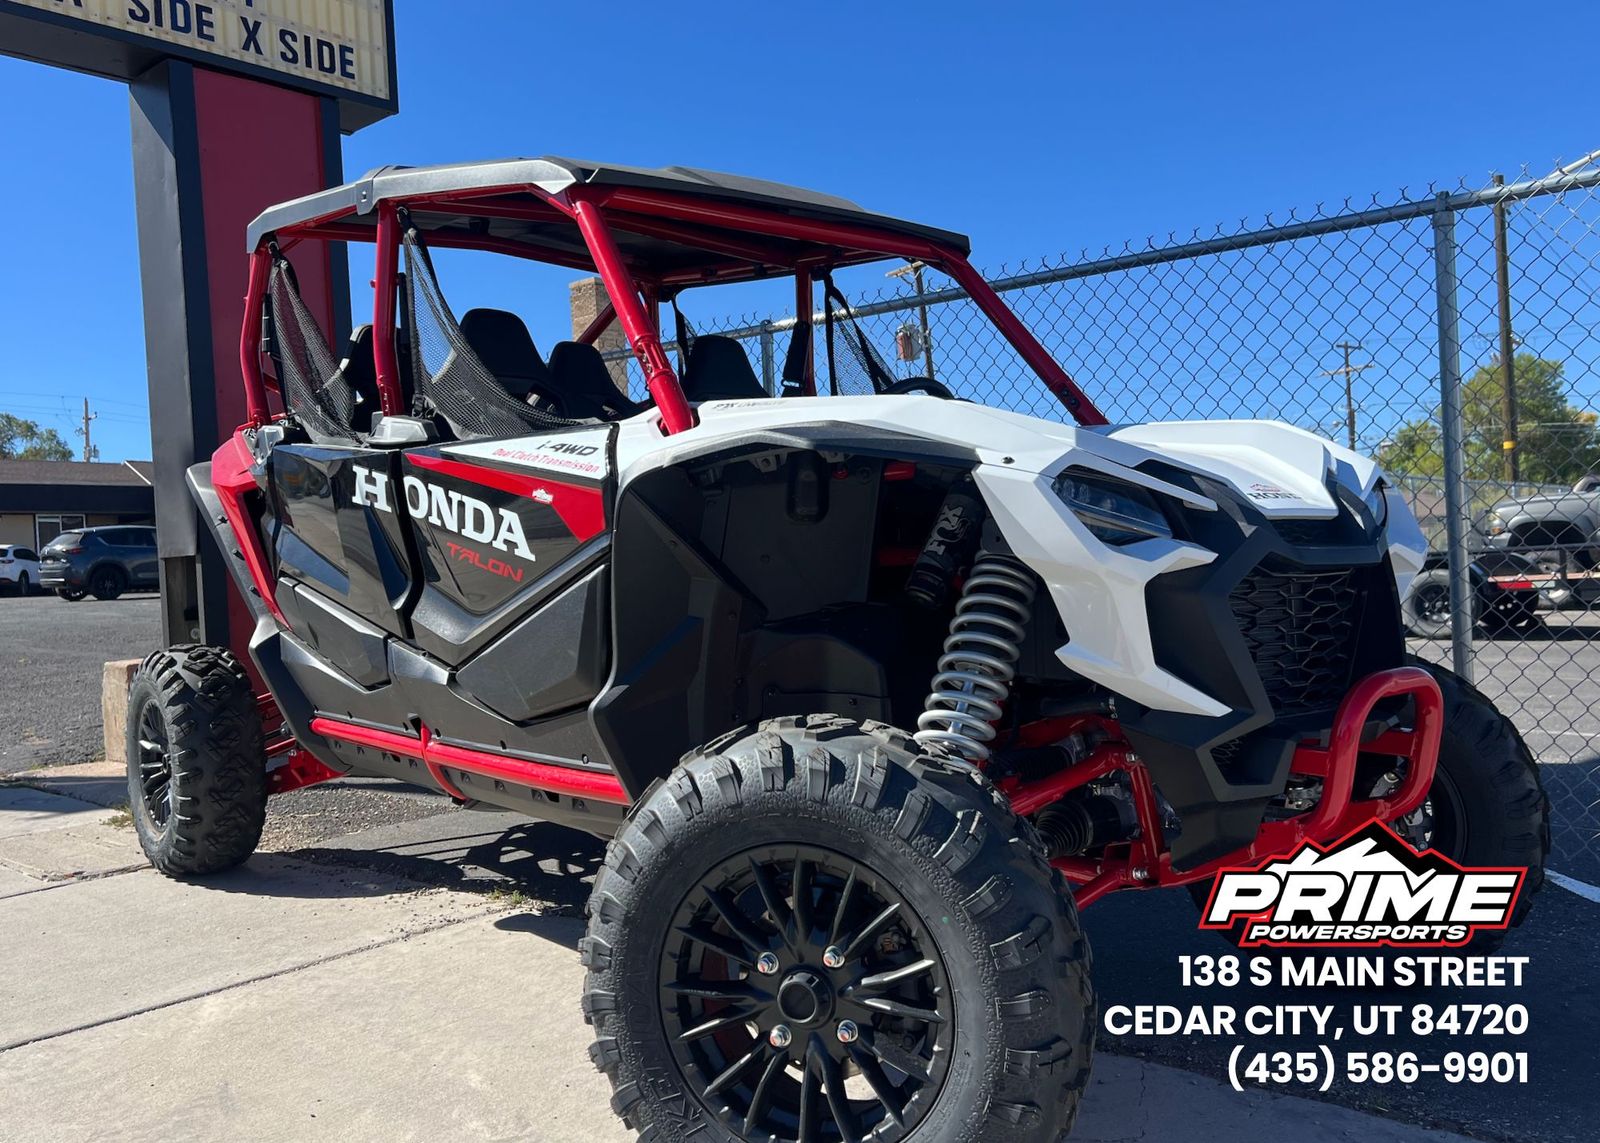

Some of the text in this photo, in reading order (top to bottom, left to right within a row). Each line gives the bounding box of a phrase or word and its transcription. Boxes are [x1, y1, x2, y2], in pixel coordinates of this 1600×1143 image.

[128, 0, 356, 80] SIDE X SIDE
[492, 447, 600, 473] Dual Clutch Transmission
[352, 465, 536, 562] HONDA
[924, 504, 969, 555] FOX
[447, 542, 524, 582] TALON
